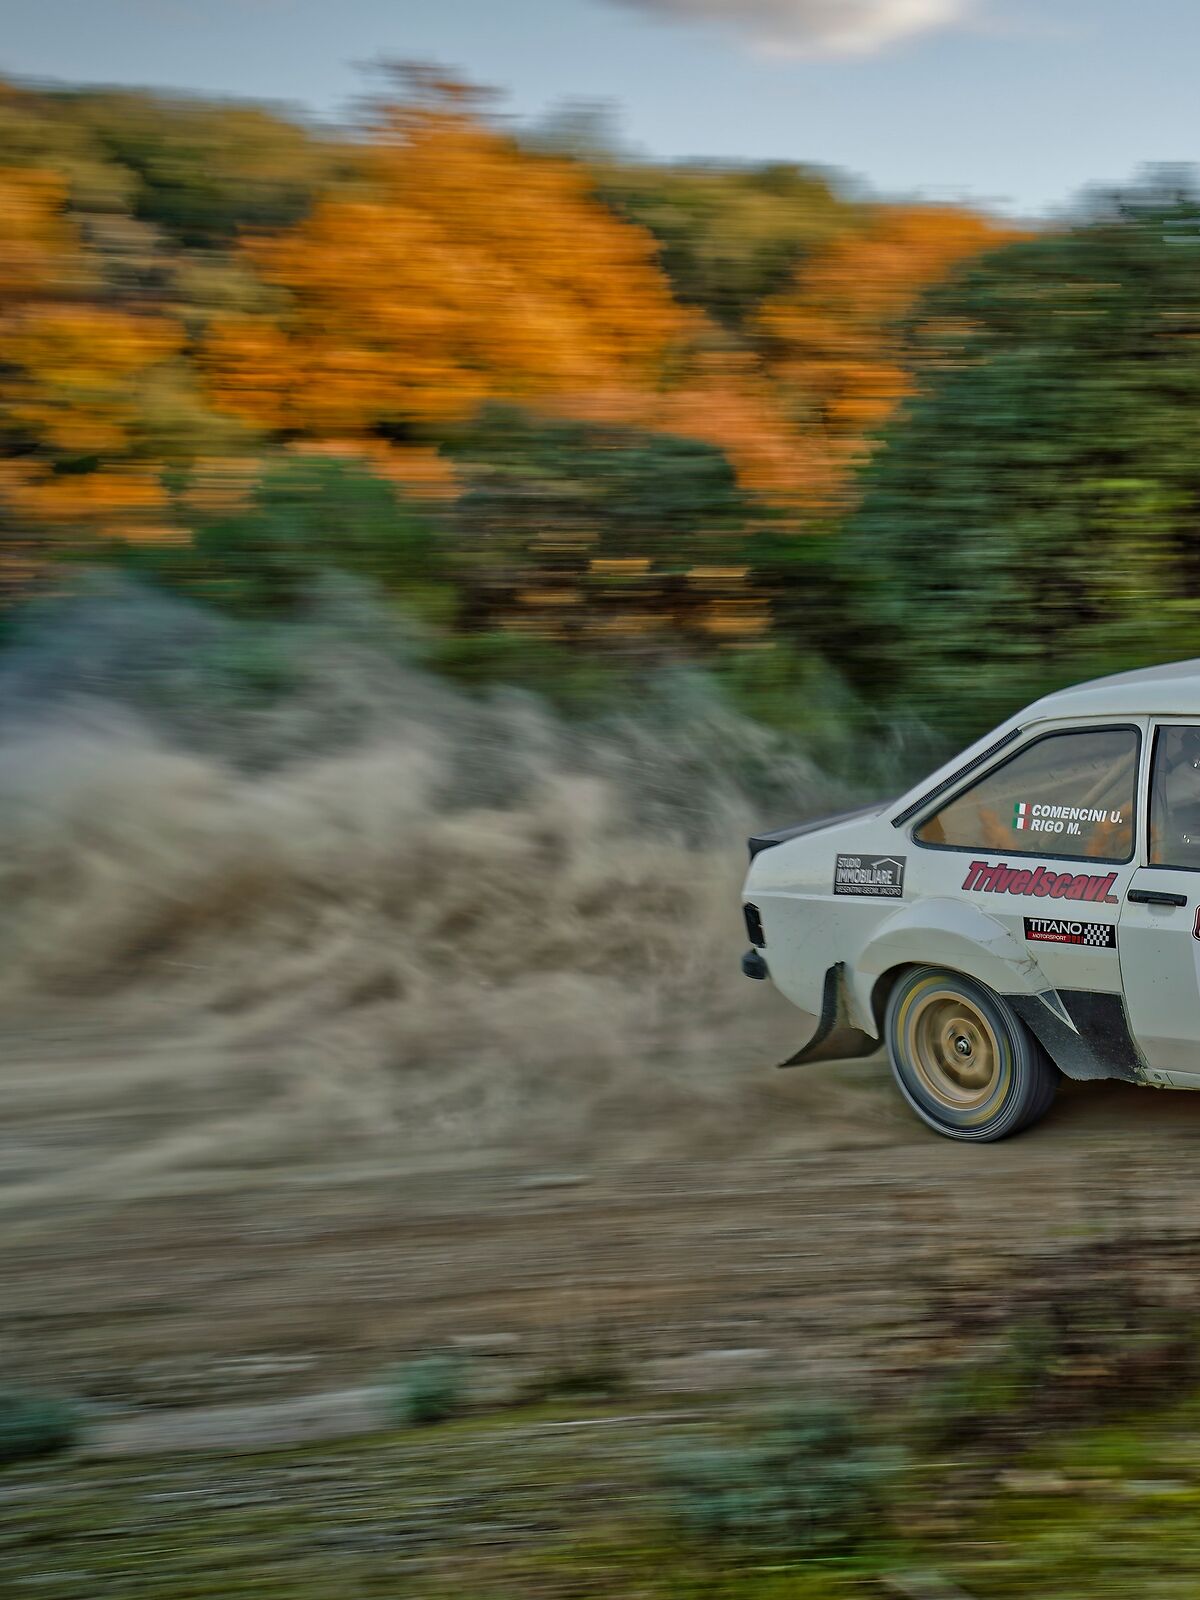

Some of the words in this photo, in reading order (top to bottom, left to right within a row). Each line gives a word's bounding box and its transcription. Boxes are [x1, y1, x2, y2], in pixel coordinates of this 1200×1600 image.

[1031, 804, 1107, 822] COMENCINI
[1110, 811, 1123, 824] U.
[1030, 819, 1064, 833] RIGO
[1066, 822, 1081, 835] M.
[837, 857, 861, 868] STUDIO
[836, 868, 893, 884] IMMOBILIARE
[962, 861, 1118, 904] Trivelscavi
[1029, 918, 1082, 935] TITANO
[1031, 933, 1067, 941] MOTORSPORT
